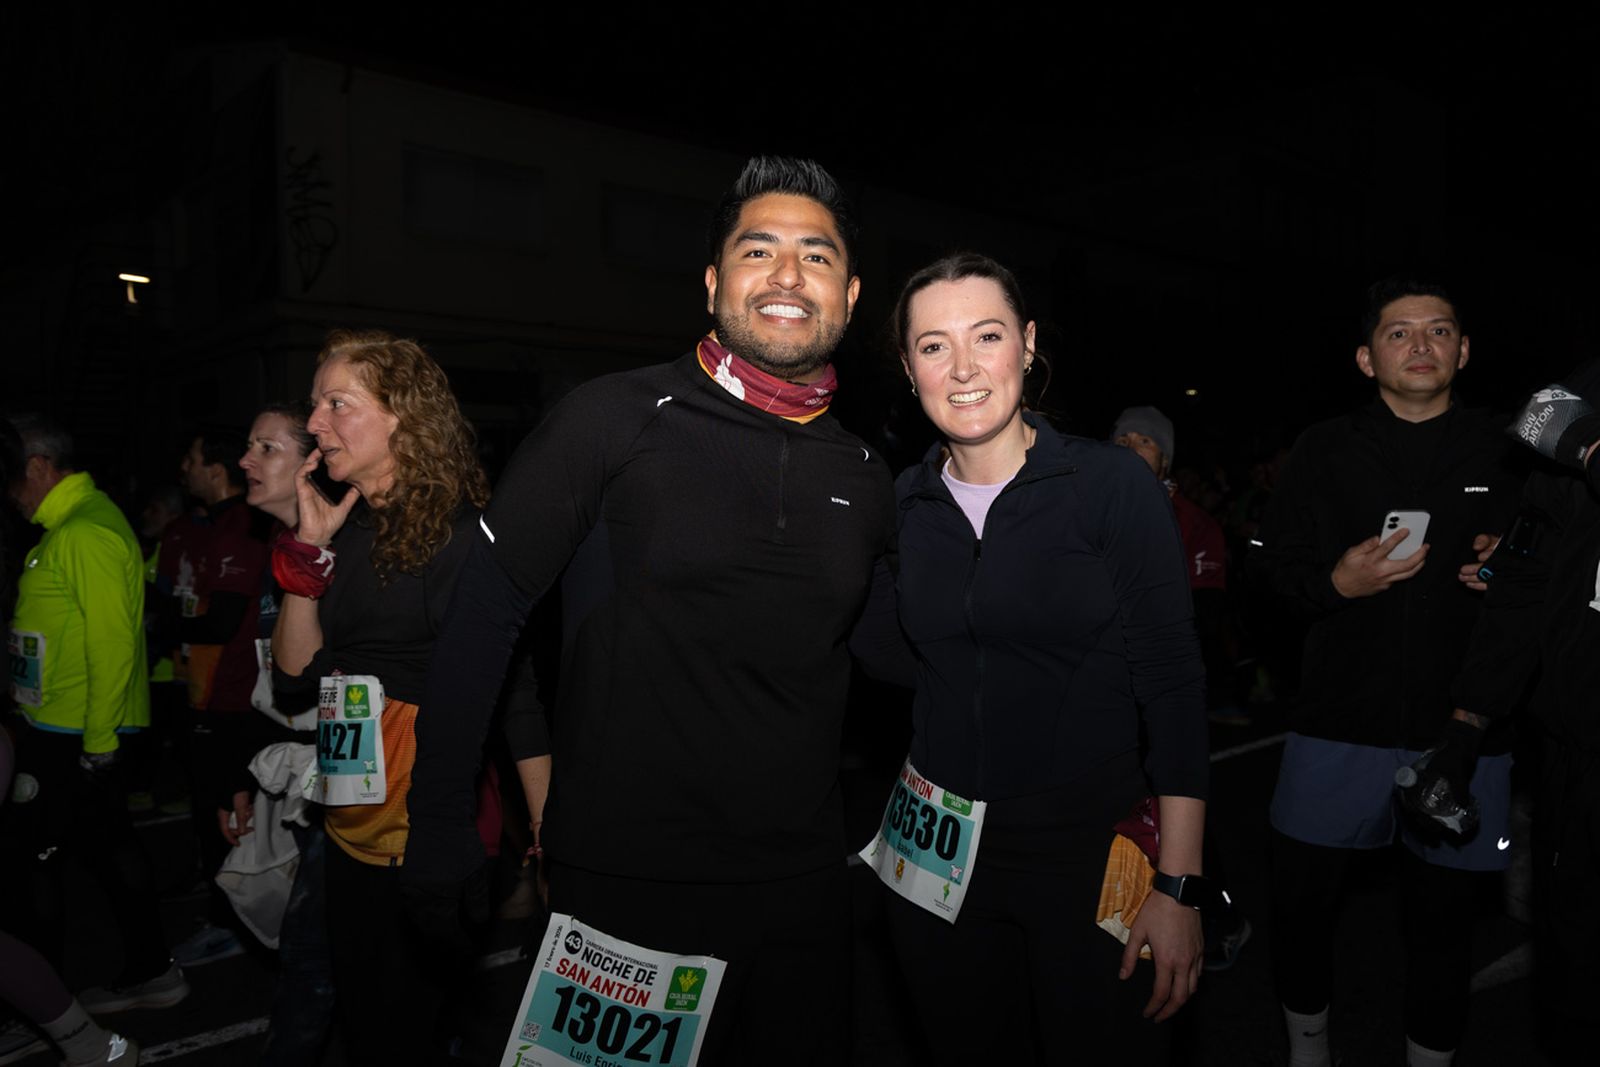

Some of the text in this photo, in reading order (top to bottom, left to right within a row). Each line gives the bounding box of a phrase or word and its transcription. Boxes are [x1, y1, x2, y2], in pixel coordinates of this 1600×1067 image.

[1520, 413, 1538, 441] SAN
[318, 723, 362, 760] 427
[888, 787, 961, 861] 13530
[565, 934, 581, 950] 43
[603, 947, 623, 960] URBANA
[622, 954, 659, 971] INTERNACIONAL
[556, 958, 651, 1008] SAN ANTÓN
[581, 946, 658, 987] NOCHE DE
[552, 985, 683, 1064] 13021
[569, 1046, 623, 1067] Luis Enri
